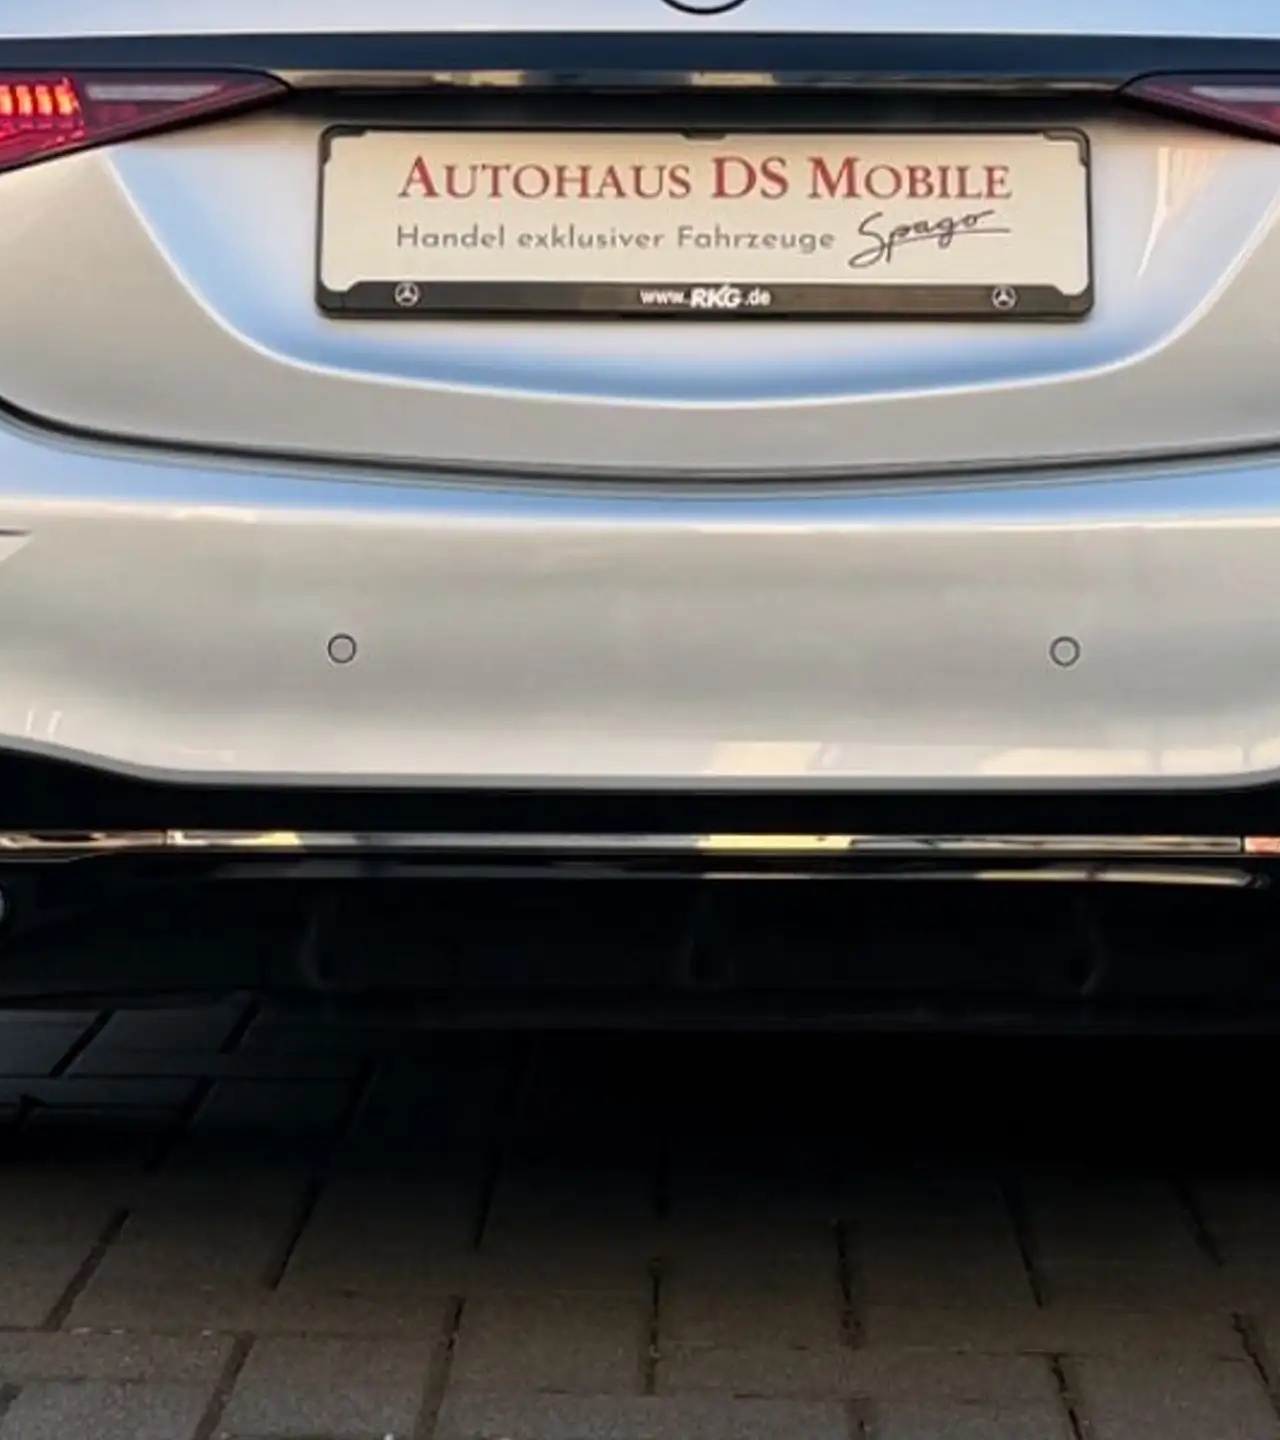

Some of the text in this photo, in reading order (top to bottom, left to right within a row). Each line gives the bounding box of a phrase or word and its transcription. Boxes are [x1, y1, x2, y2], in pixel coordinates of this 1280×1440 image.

[398, 155, 1014, 200] AUTOHAUS DS MOBILE
[396, 223, 837, 254] Handel exklusiver Fahrzeuge
[847, 208, 1011, 269] Spago
